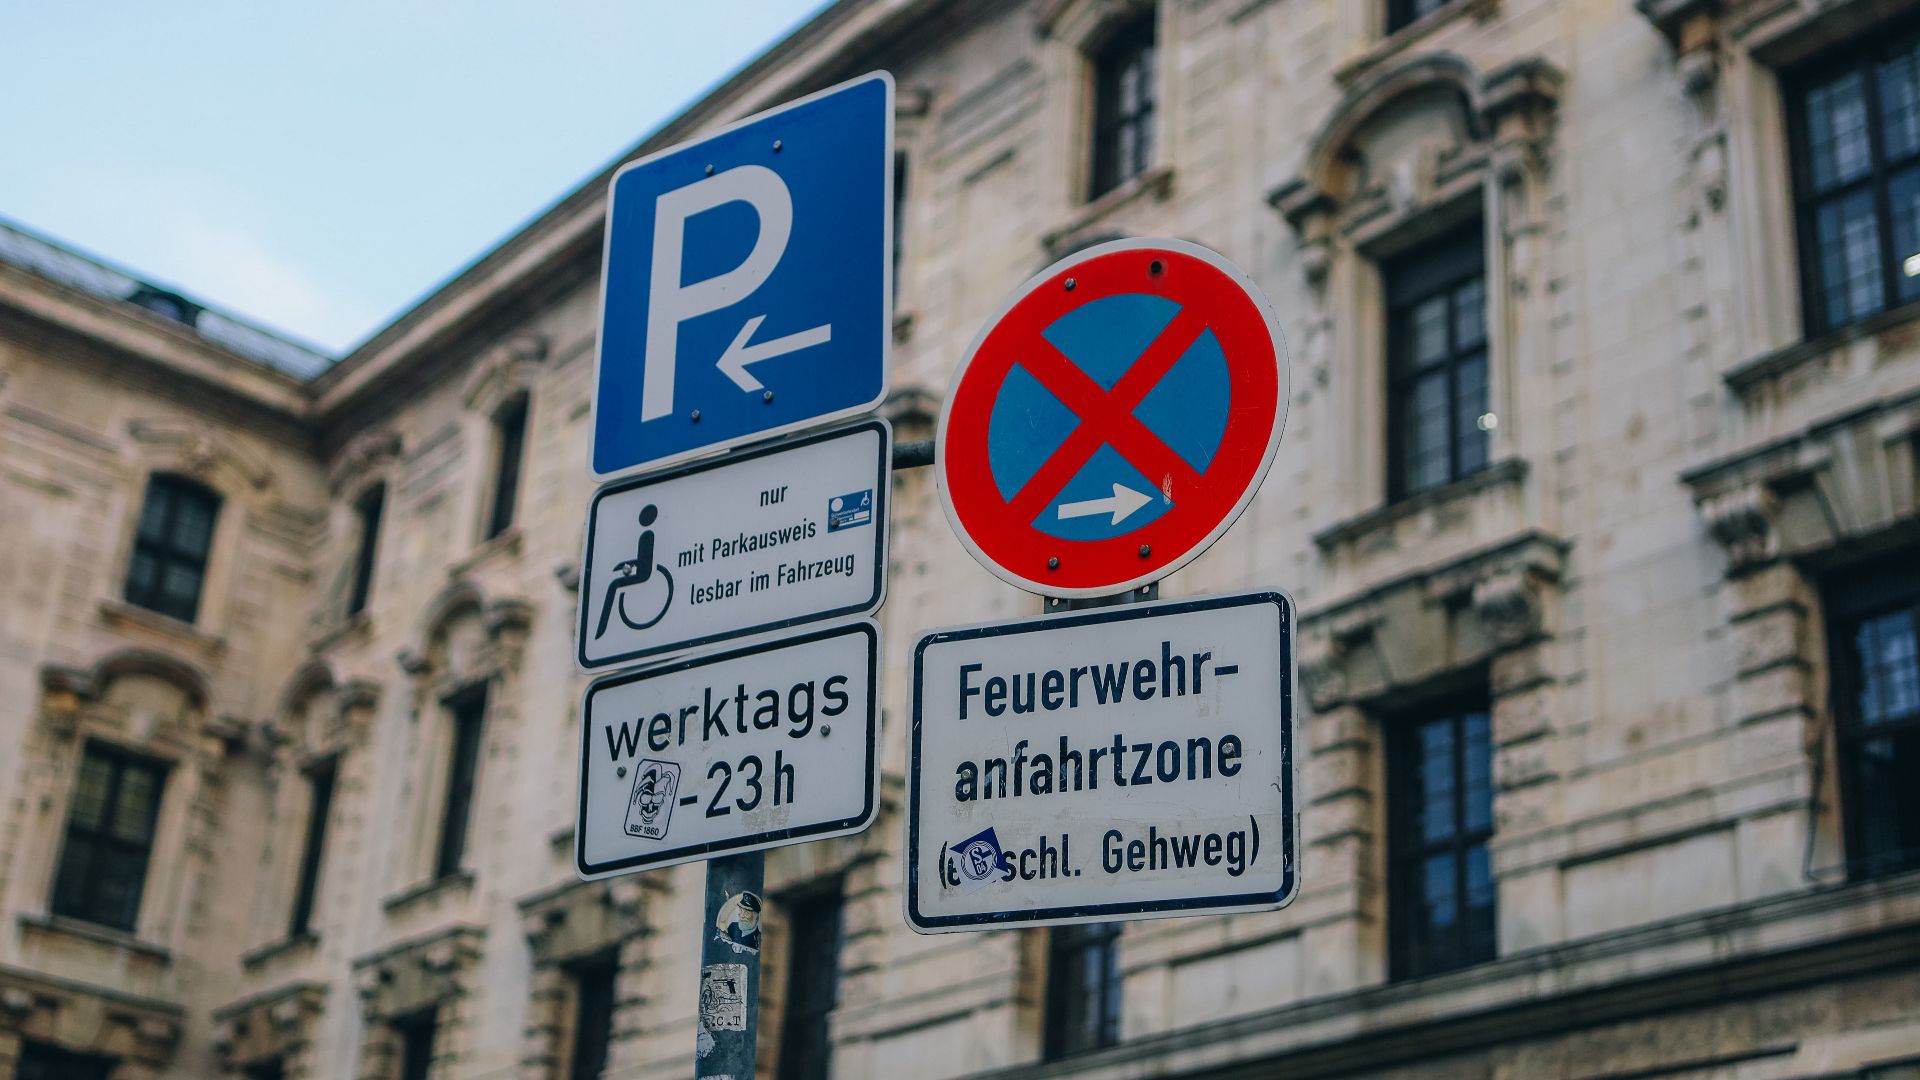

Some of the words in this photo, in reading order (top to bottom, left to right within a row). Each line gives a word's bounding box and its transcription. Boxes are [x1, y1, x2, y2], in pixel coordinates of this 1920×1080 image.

[641, 164, 793, 423] P
[759, 485, 788, 507] nur
[678, 543, 705, 568] mit
[712, 517, 816, 561] Parkausweis
[690, 578, 742, 606] lesbar
[749, 570, 770, 593] im
[777, 553, 855, 587] Fahrzeug
[959, 640, 1239, 721] Feuerwehr-
[604, 674, 849, 762] werktags
[954, 733, 1242, 802] anfahrtzone
[1102, 814, 1260, 877] Gehweg)
